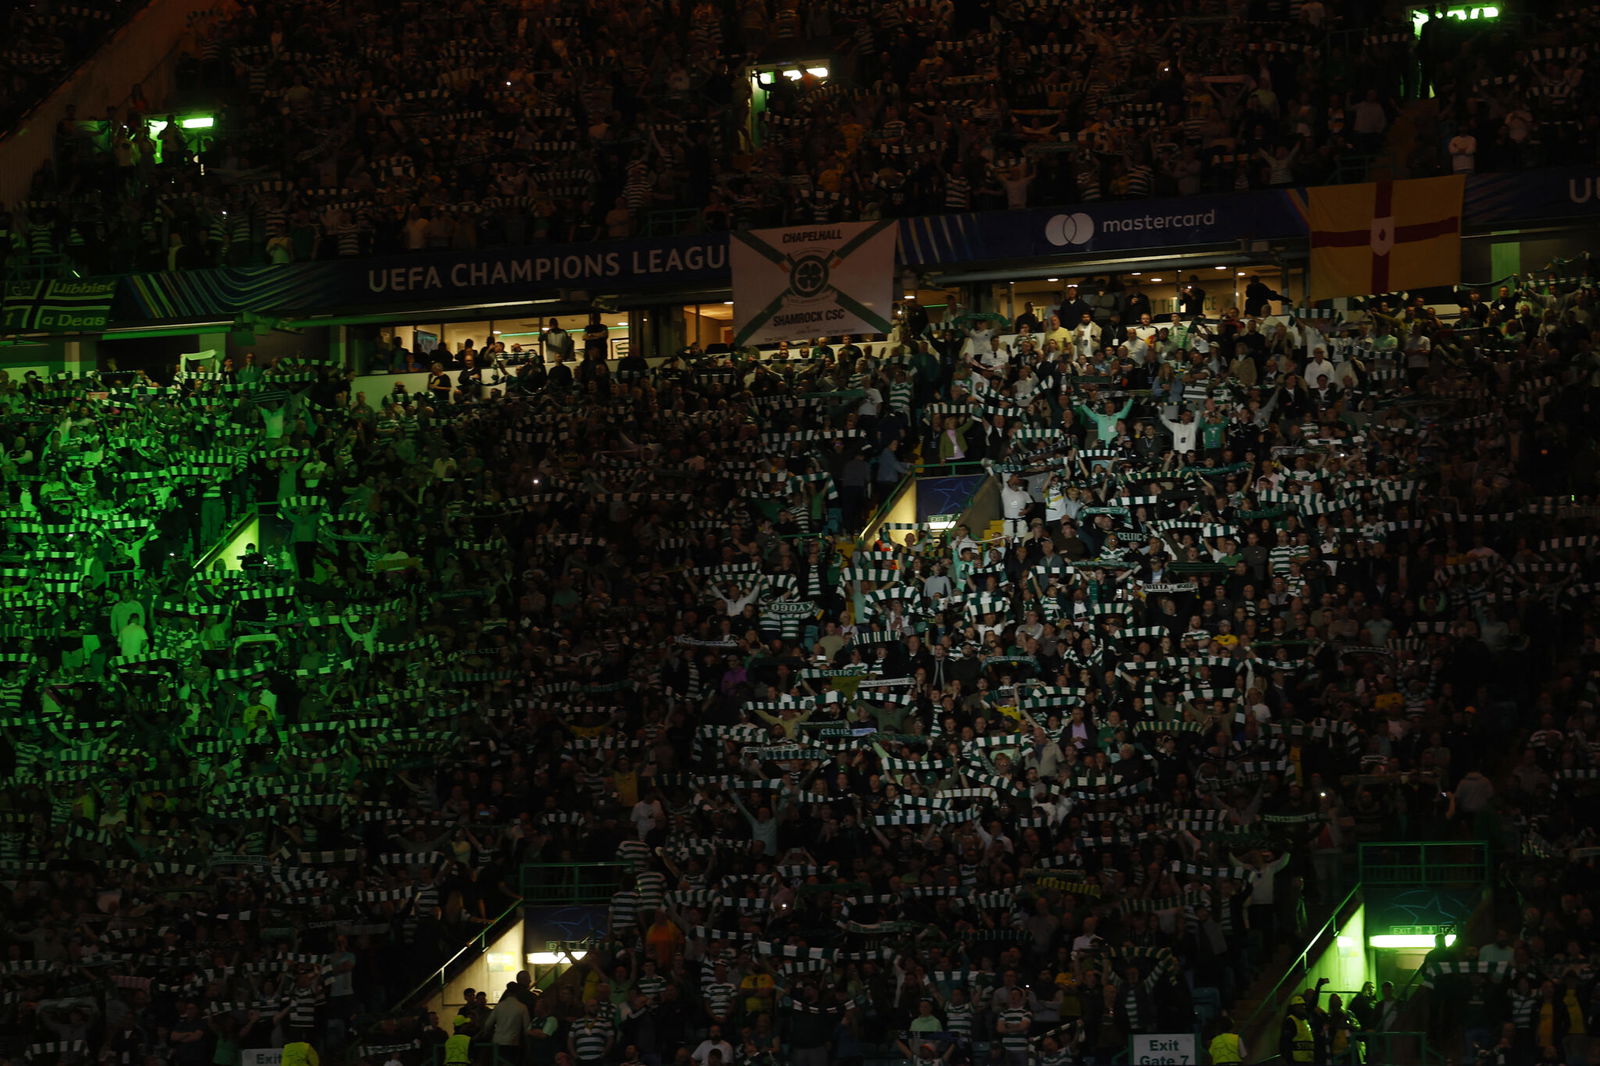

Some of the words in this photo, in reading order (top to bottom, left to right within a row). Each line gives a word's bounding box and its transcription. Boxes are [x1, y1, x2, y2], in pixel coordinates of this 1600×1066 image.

[1568, 177, 1600, 204] U
[1103, 209, 1216, 233] mastercard
[782, 229, 842, 244] CHAPELHALL
[369, 266, 442, 293] UEFA
[451, 252, 620, 288] CHAMPIONS
[632, 244, 726, 275] LEAGU
[57, 314, 107, 327] Deas
[773, 310, 823, 327] SHAMROCK
[826, 308, 845, 321] CSC
[822, 669, 852, 677] CELTIC
[1149, 1040, 1179, 1051] Exit
[1140, 1055, 1175, 1066] Gate
[1180, 1056, 1189, 1066] 7
